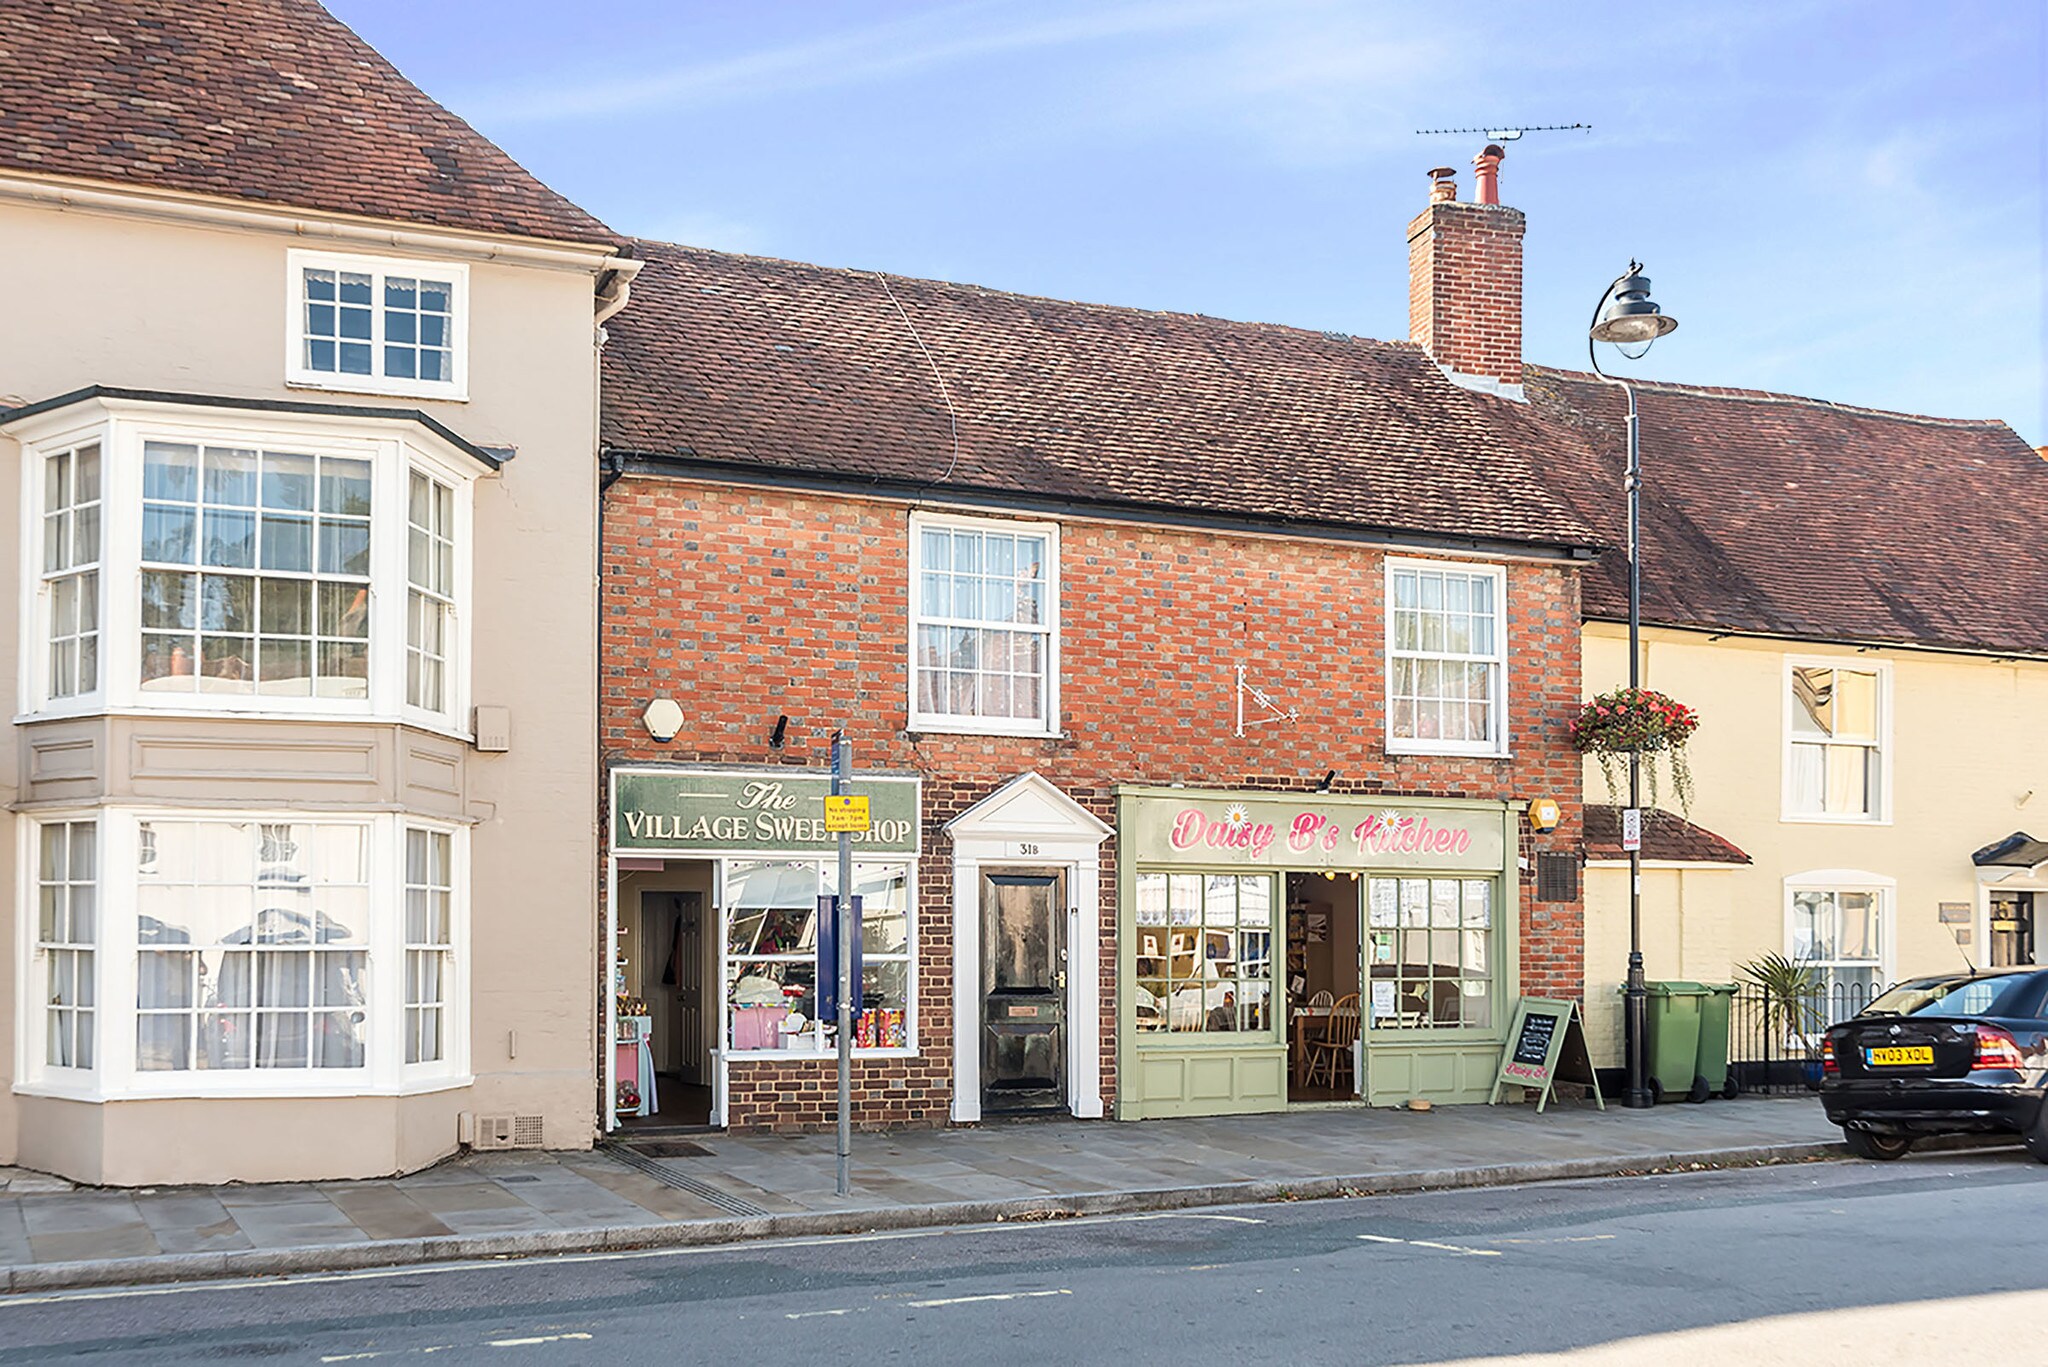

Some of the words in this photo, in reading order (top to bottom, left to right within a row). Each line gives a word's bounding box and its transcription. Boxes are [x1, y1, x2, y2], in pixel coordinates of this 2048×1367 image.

[736, 781, 797, 810] The
[622, 810, 750, 840] VILLAGE
[1170, 808, 1276, 858] Daisy
[1287, 812, 1340, 852] B's
[1352, 813, 1472, 855] Kitchen
[1505, 1063, 1533, 1079] Daisy
